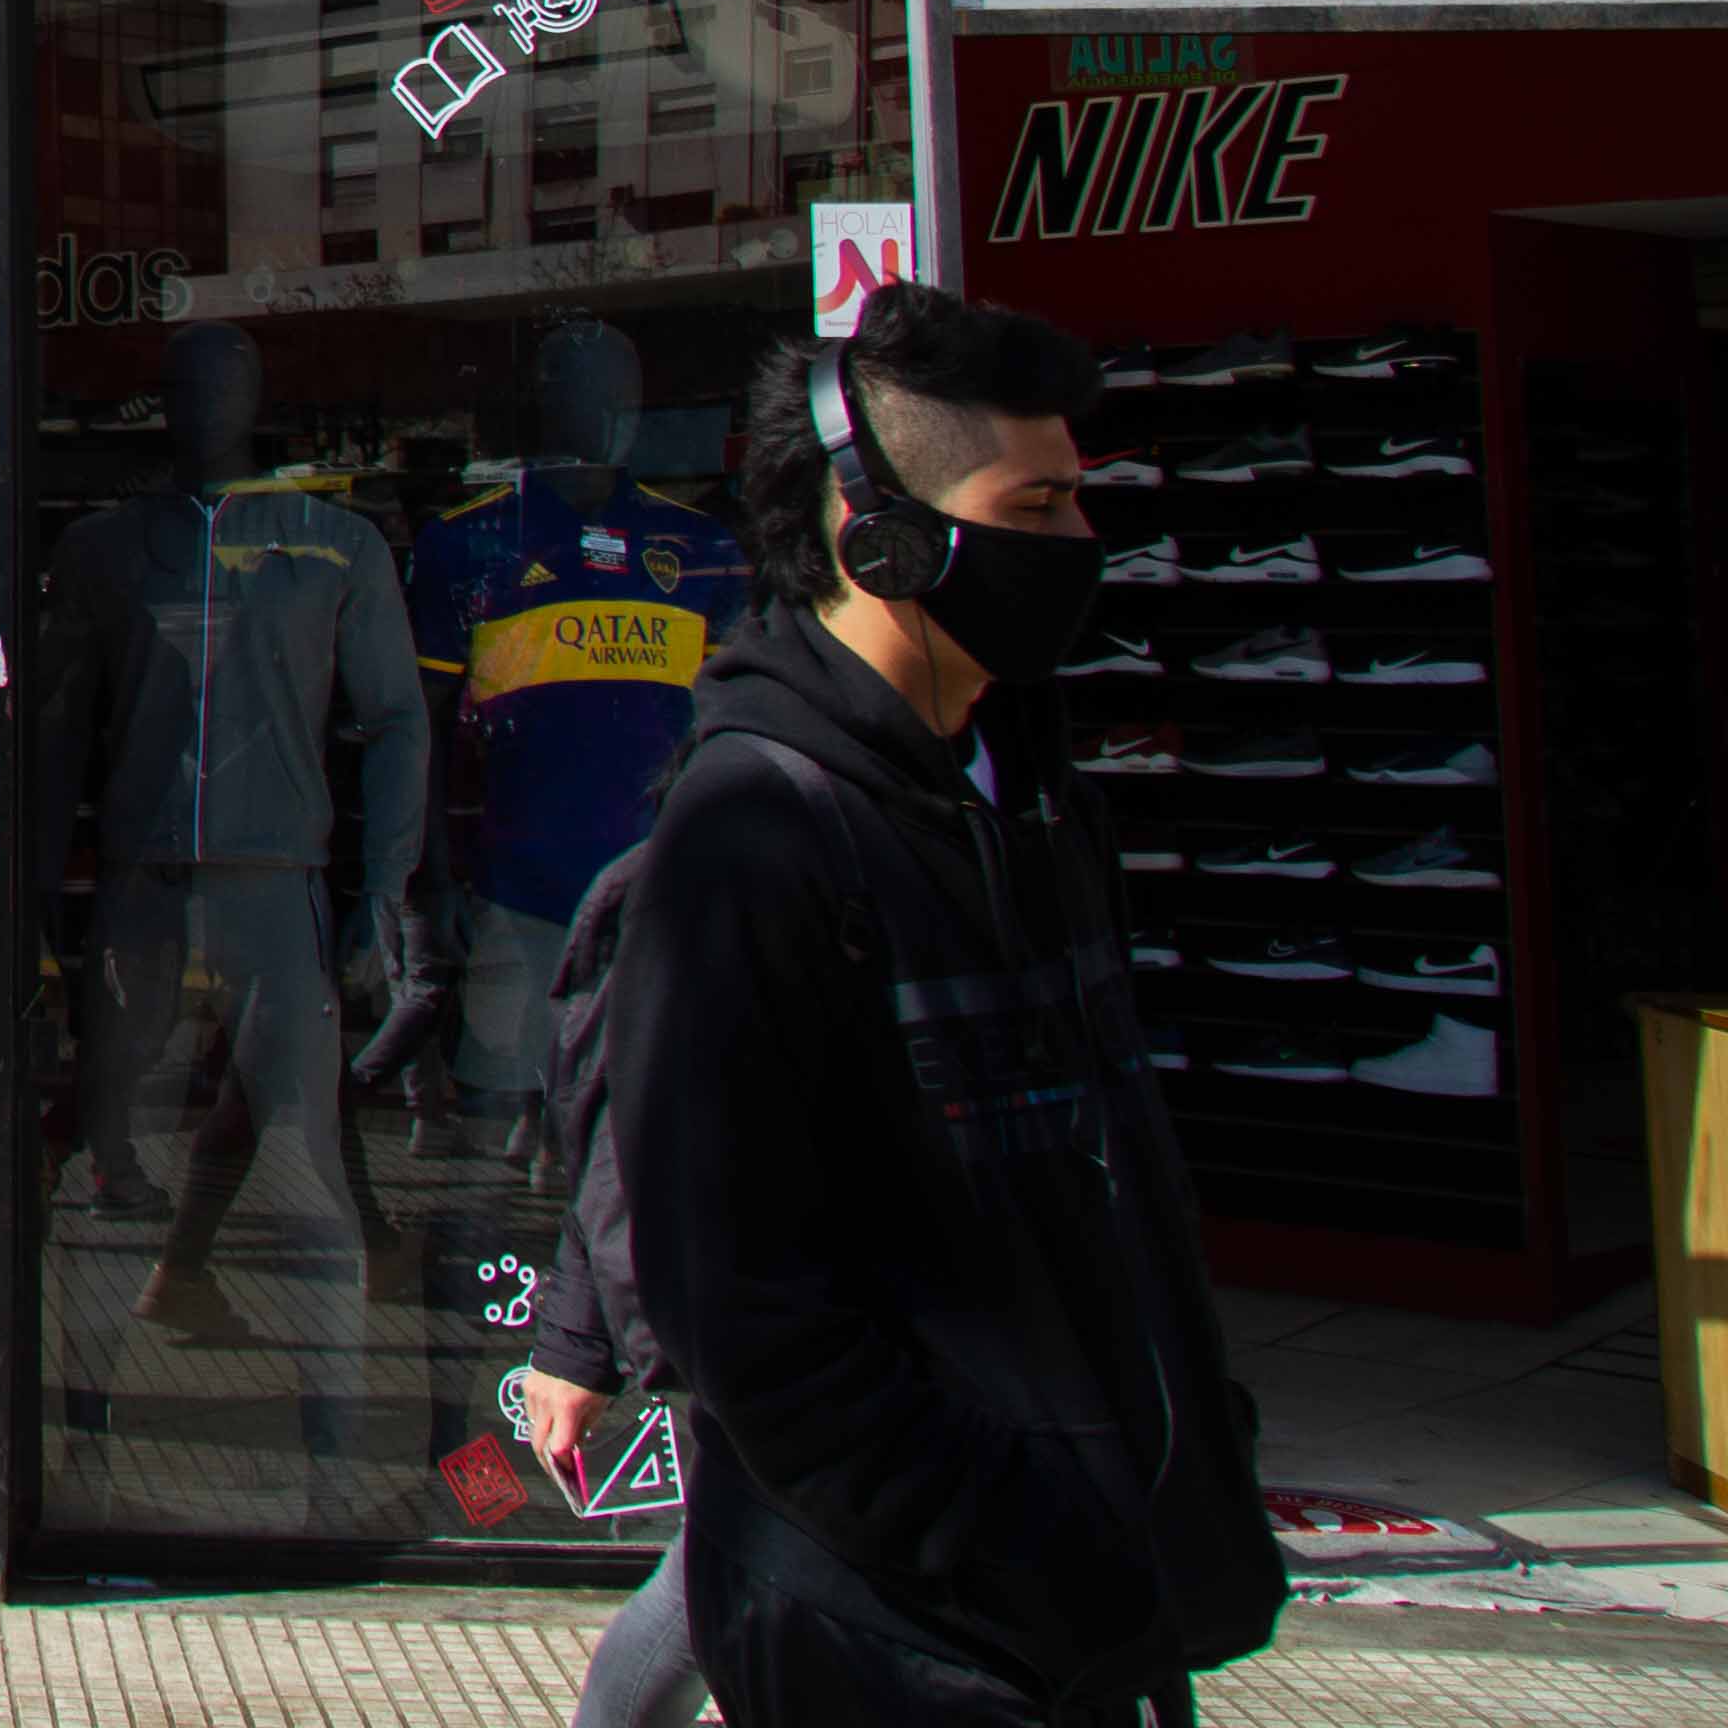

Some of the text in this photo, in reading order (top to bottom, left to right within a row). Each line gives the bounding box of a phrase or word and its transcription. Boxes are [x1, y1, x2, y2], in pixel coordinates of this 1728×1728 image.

[987, 73, 1350, 243] NIKE
[819, 211, 906, 236] HOLA!
[555, 613, 669, 650] QATAR
[587, 646, 668, 668] AIRWAYS
